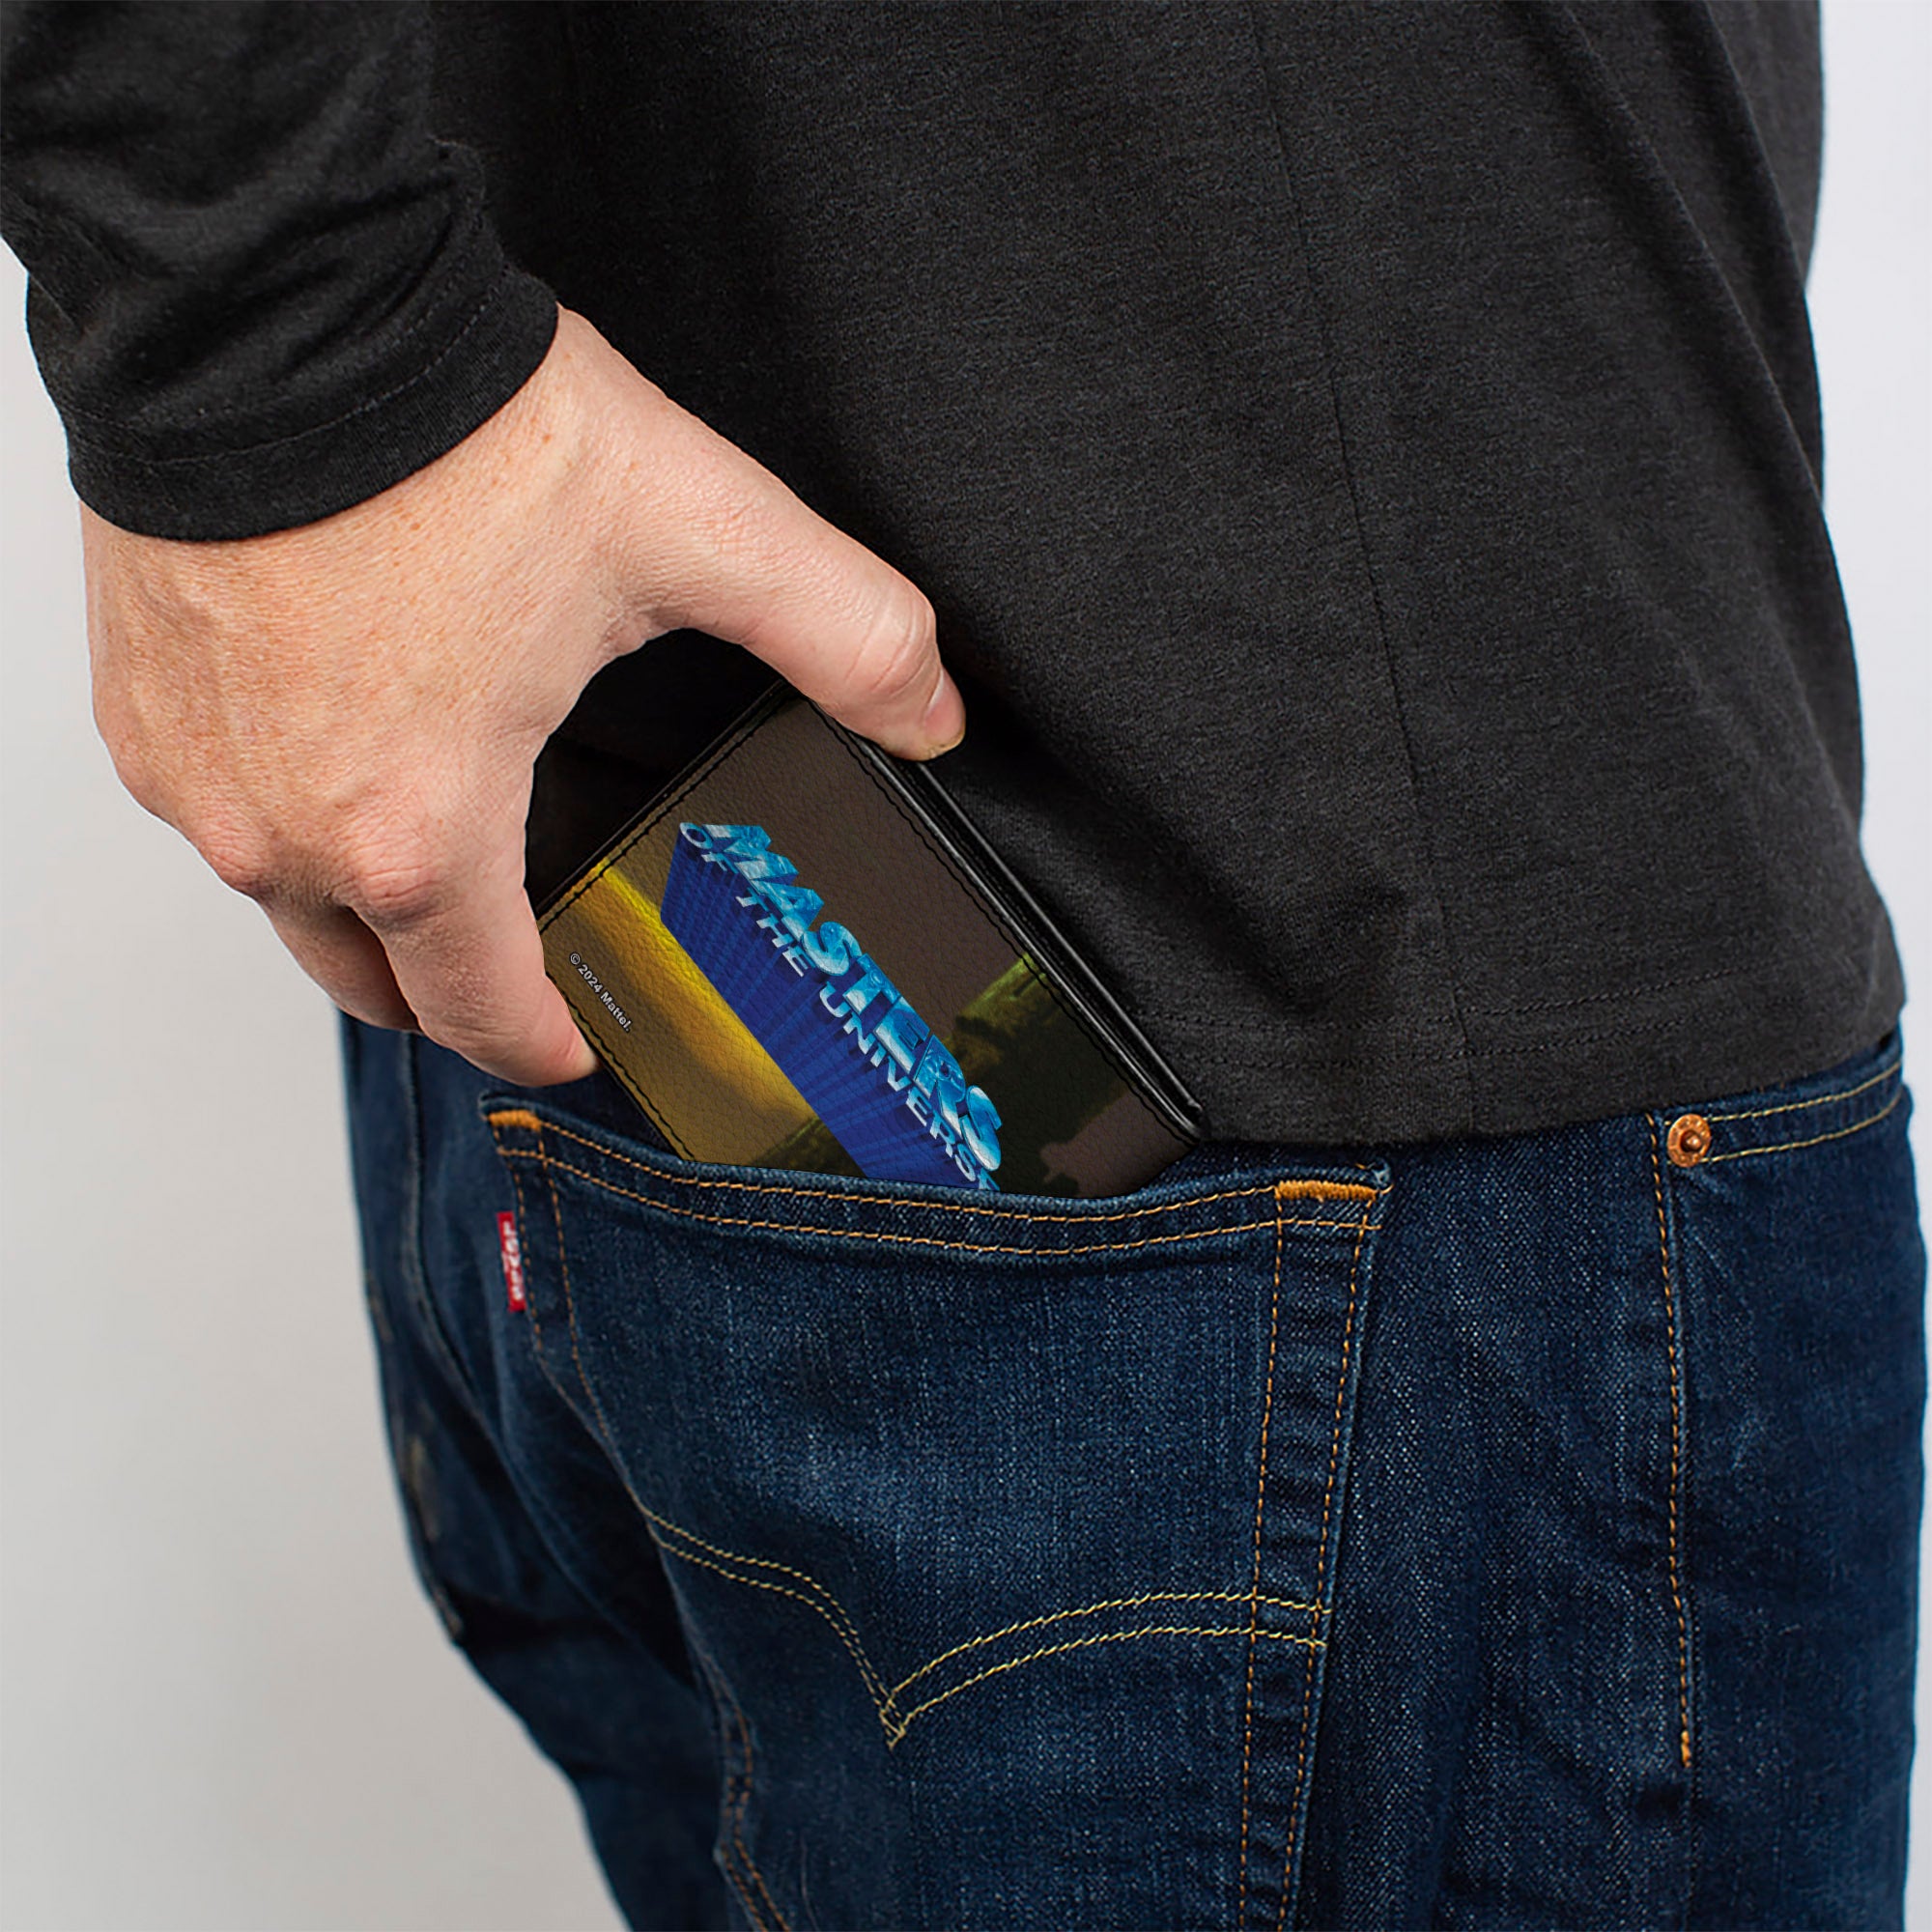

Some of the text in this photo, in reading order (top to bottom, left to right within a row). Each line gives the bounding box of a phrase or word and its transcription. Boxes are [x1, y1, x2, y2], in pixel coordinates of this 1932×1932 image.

[680, 822, 737, 873] OF
[735, 887, 813, 978] THE
[578, 964, 603, 993] 2024
[600, 991, 632, 1032] Mattel.
[702, 824, 1003, 1171] MASTERS
